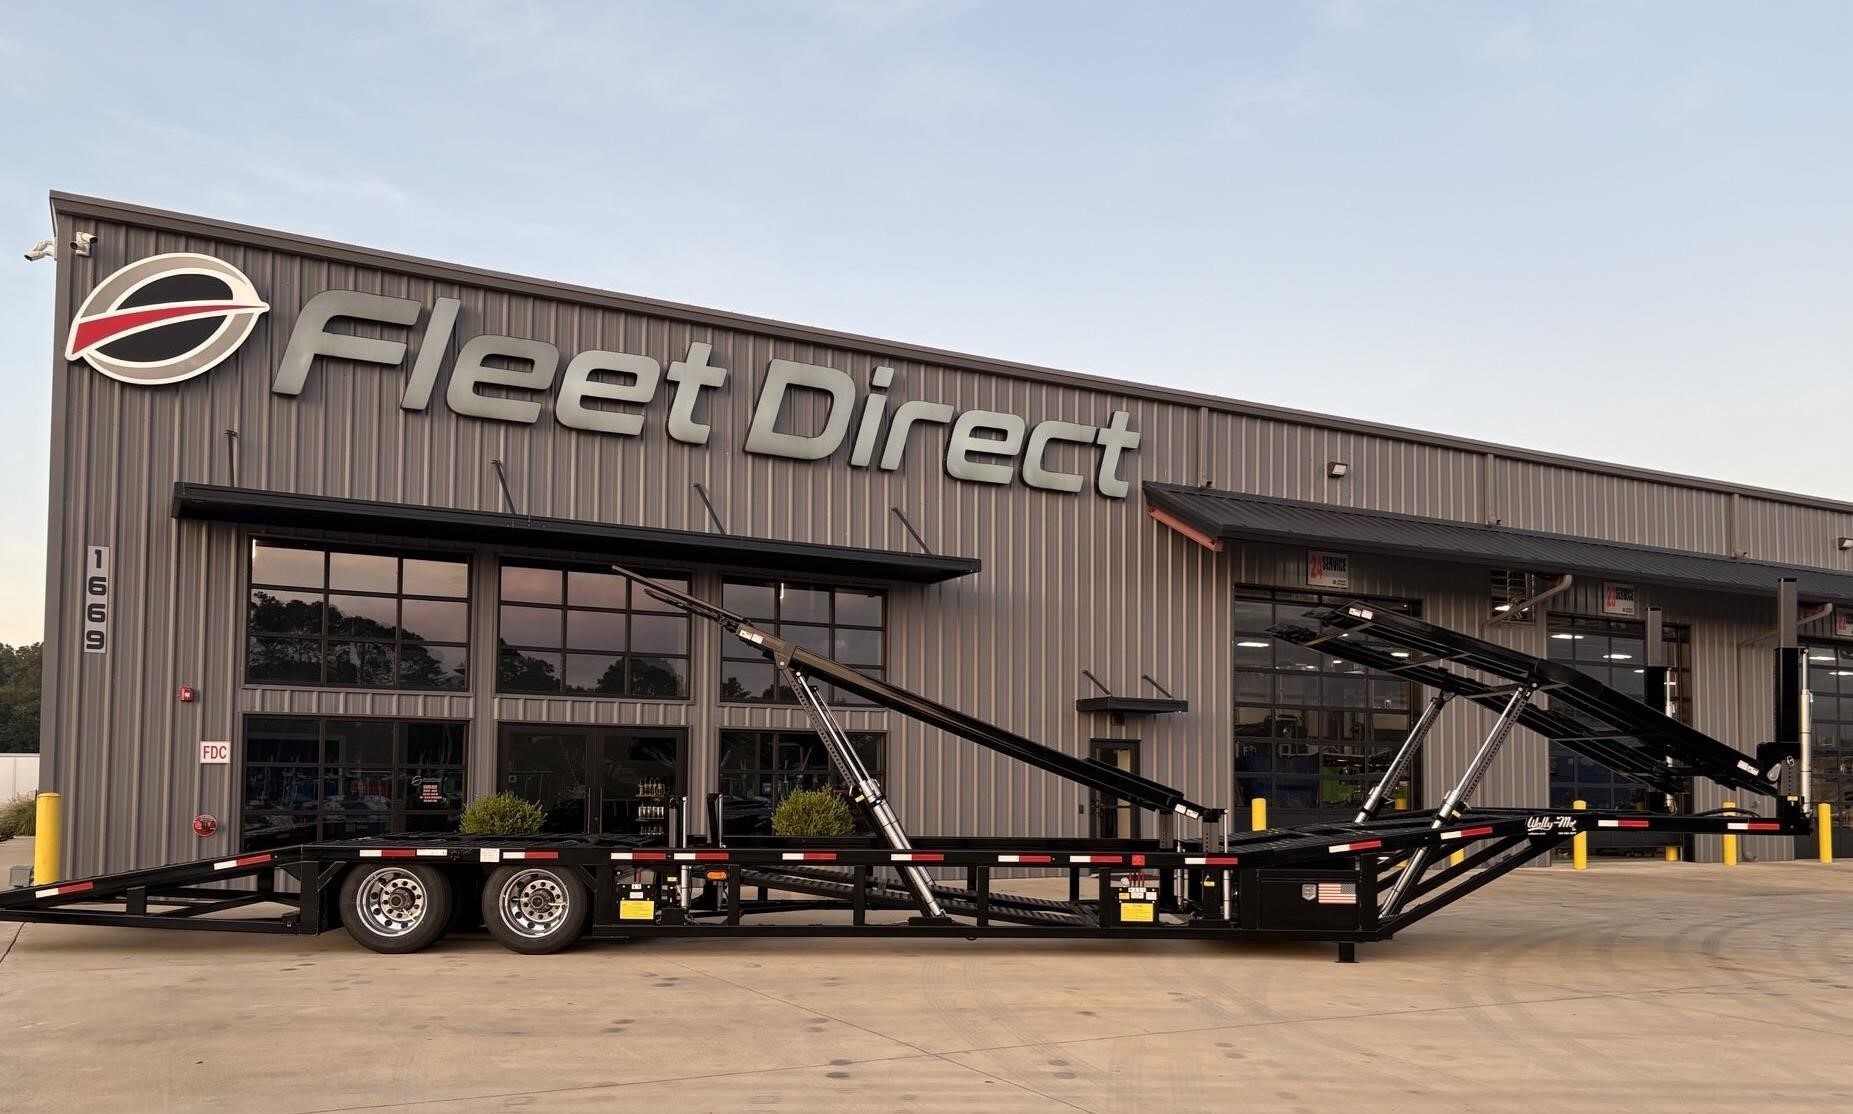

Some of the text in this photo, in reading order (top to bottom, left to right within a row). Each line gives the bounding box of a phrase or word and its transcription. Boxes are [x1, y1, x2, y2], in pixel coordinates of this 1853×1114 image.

[272, 289, 1141, 498] Fleet Direct
[1322, 556, 1346, 572] SERVICE
[86, 549, 107, 650] 1669
[203, 745, 227, 759] FDC
